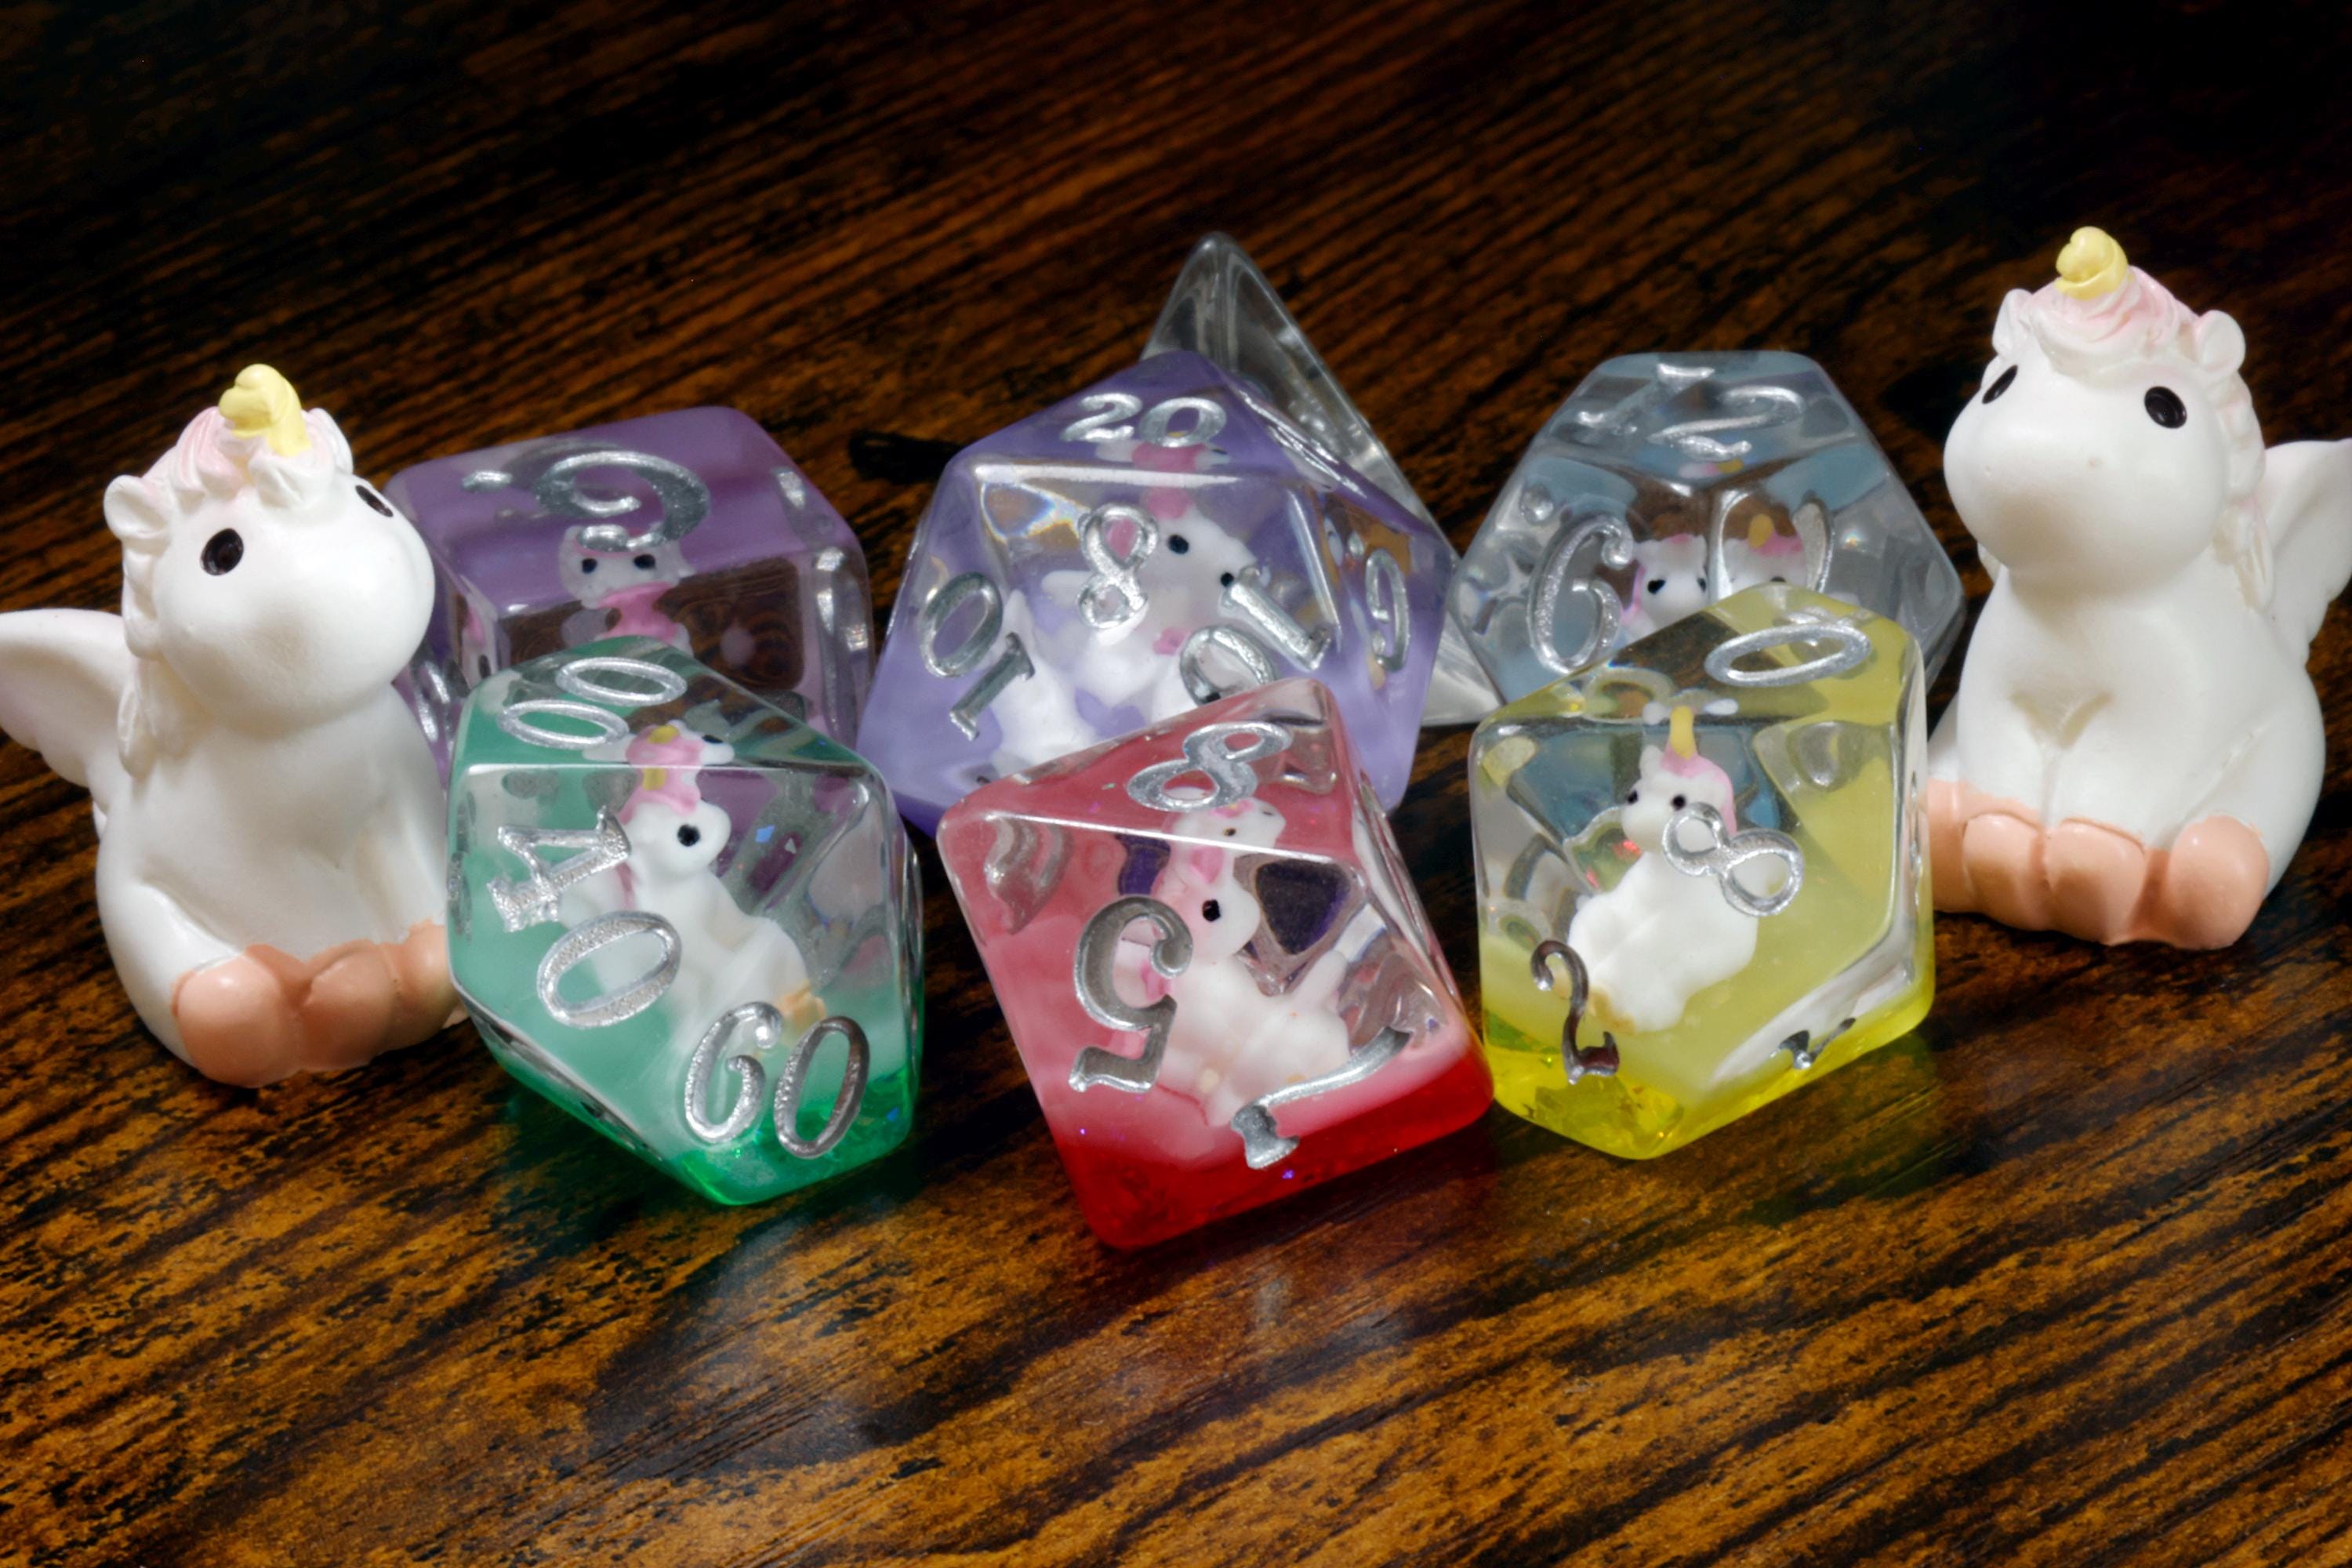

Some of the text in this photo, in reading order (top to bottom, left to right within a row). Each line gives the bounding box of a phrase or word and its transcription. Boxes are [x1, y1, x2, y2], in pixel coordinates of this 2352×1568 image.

[1061, 391, 1228, 448] 20
[1078, 502, 1159, 630] 8
[496, 655, 688, 751] 00
[1704, 624, 1872, 688] 0
[1126, 720, 1294, 814] 8
[1661, 801, 1804, 918] 8
[1530, 939, 1621, 1085] 2
[684, 1000, 870, 1160] 60
